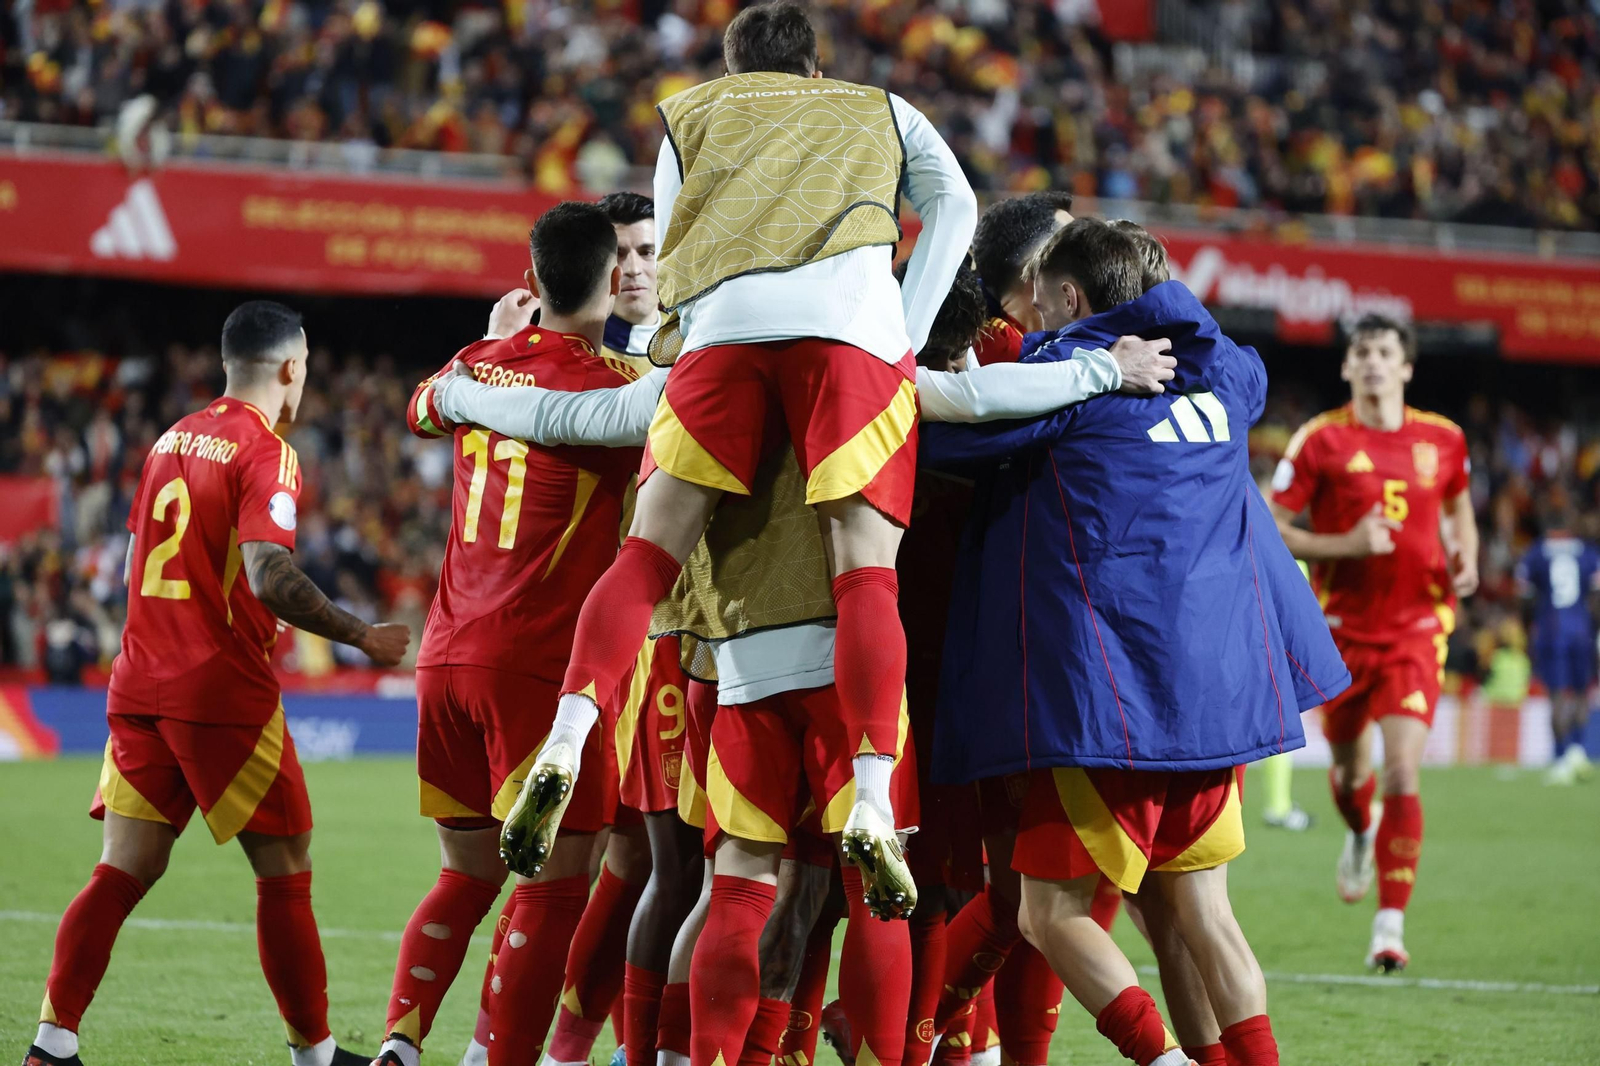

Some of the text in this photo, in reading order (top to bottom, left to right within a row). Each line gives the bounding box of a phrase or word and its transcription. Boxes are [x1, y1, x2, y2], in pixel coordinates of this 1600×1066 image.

[722, 90, 798, 99] NATIONS
[801, 88, 868, 97] LEAGUE
[152, 430, 238, 464] PEDRO PORRO
[462, 429, 529, 549] 11
[1383, 479, 1409, 522] 5
[141, 476, 191, 599] 2
[657, 684, 685, 740] 9
